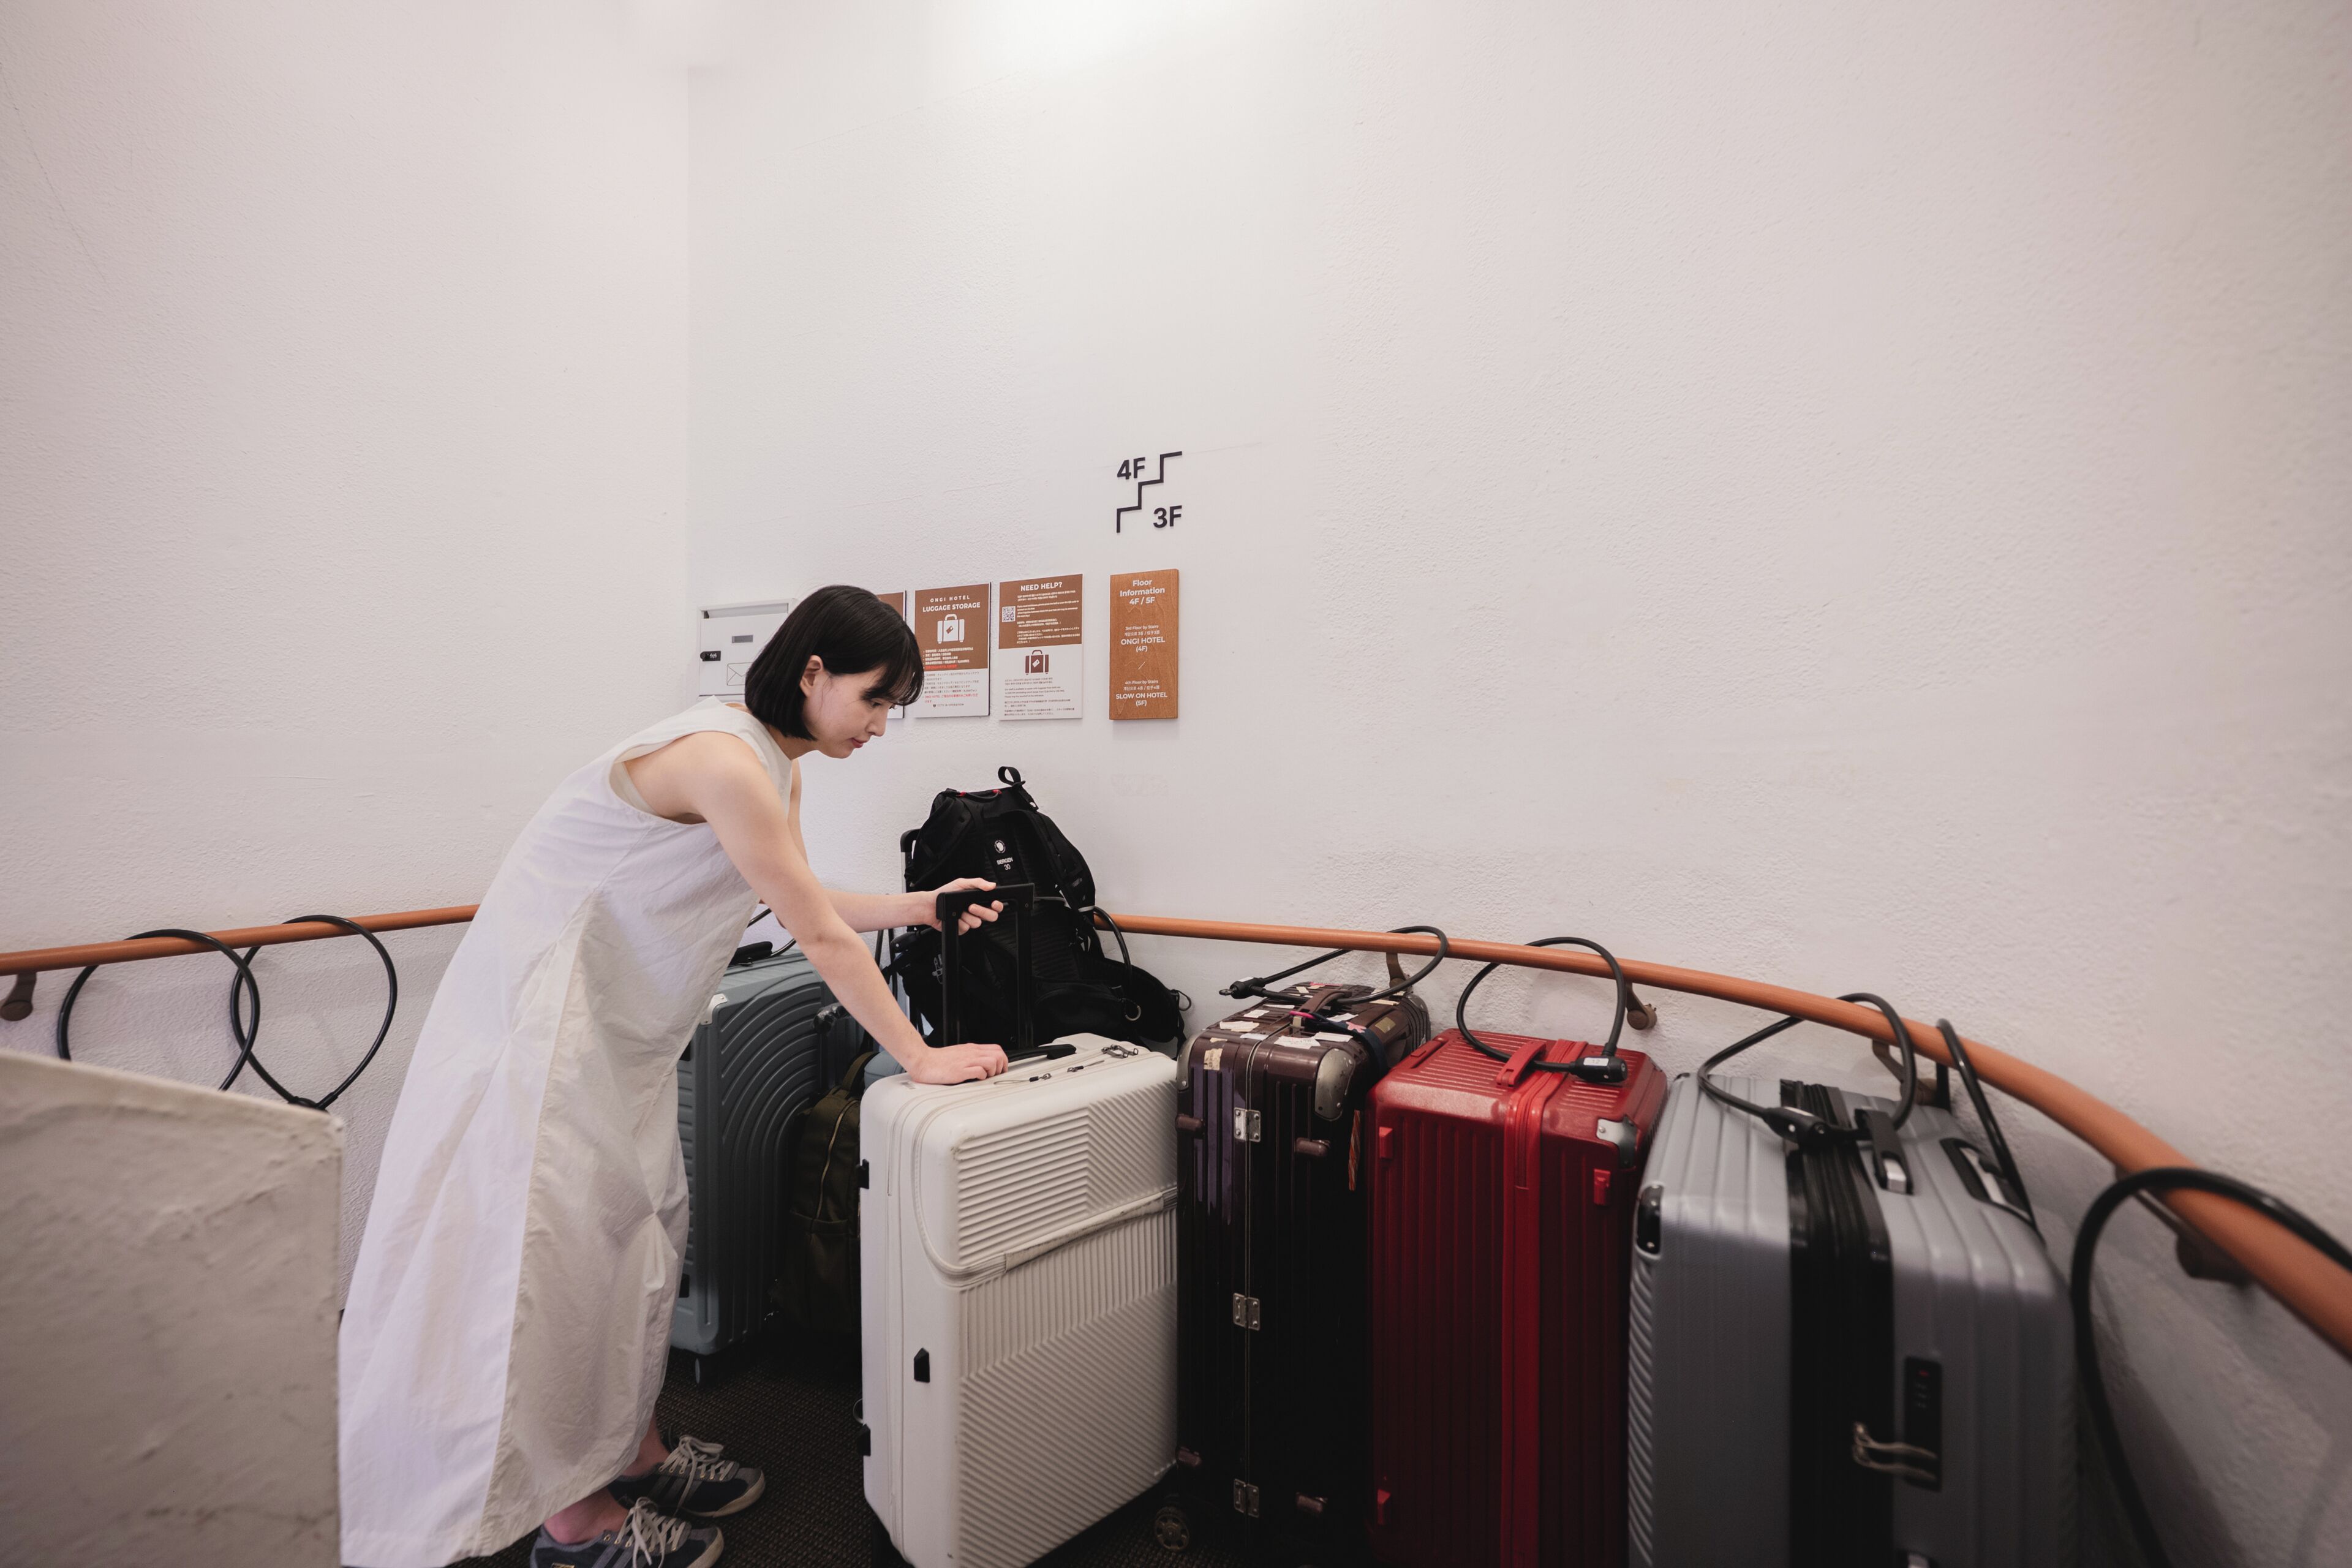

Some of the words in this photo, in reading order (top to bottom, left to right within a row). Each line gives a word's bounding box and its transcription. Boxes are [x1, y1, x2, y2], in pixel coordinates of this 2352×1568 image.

[1117, 457, 1145, 480] 4F
[1153, 505, 1182, 528] 3F
[1120, 587, 1165, 597] Information
